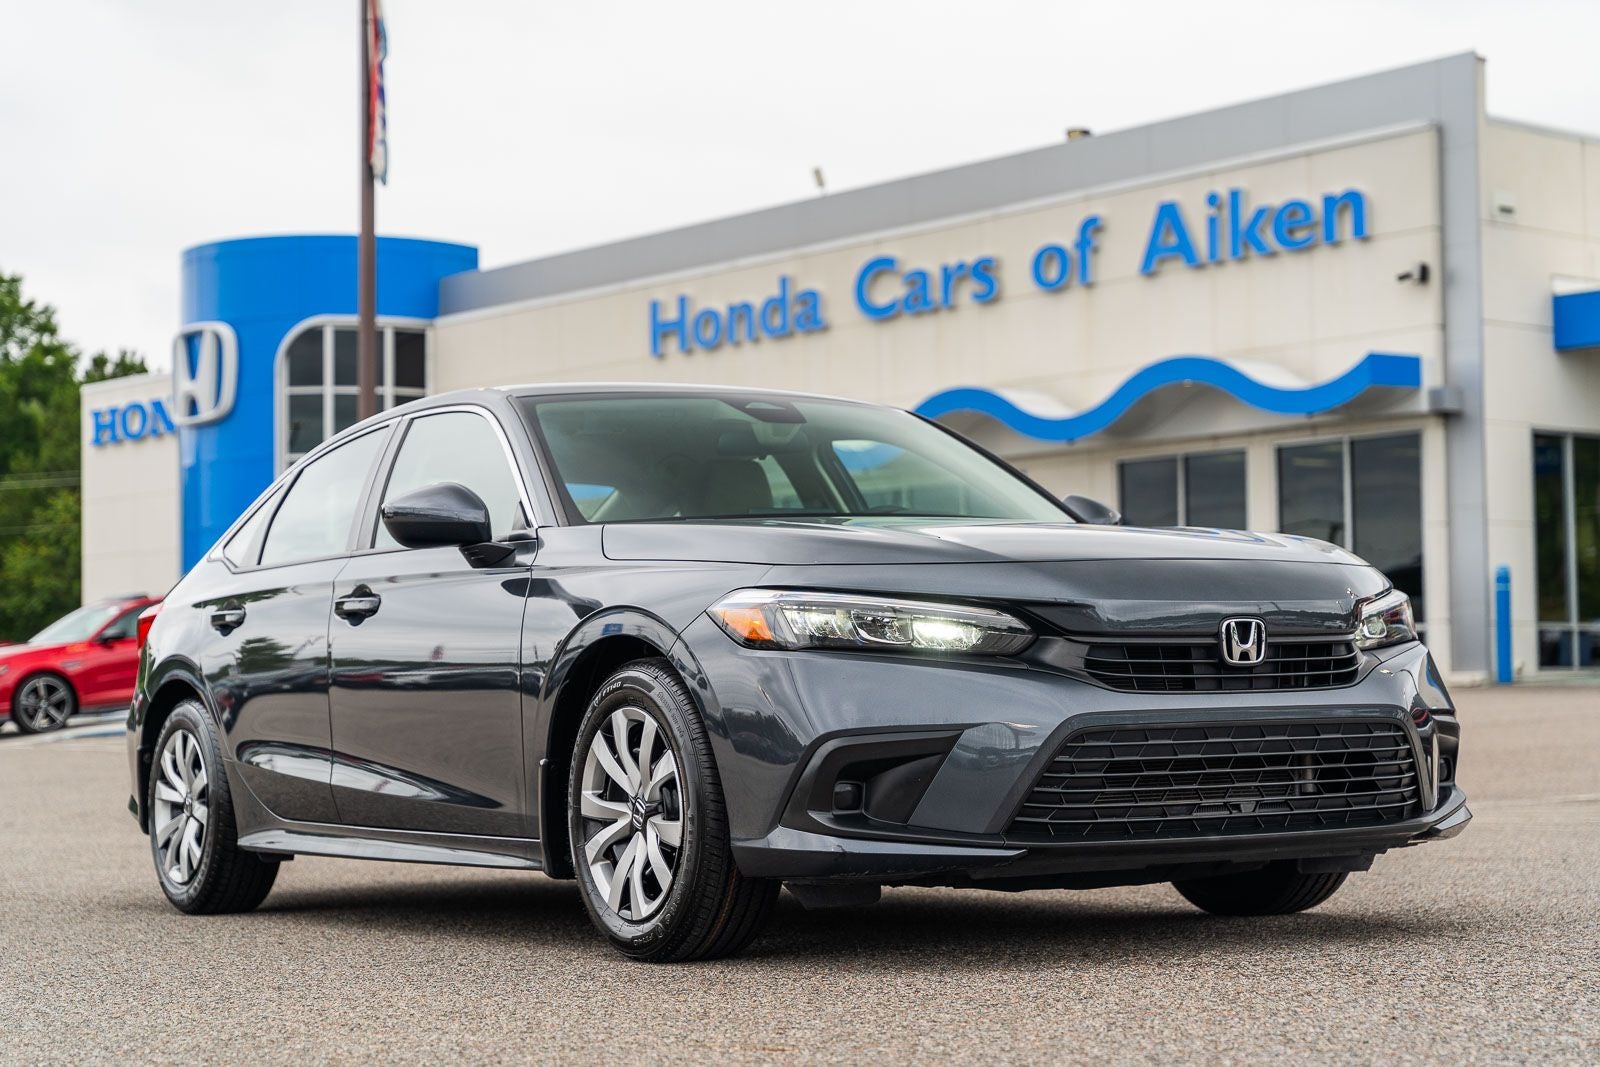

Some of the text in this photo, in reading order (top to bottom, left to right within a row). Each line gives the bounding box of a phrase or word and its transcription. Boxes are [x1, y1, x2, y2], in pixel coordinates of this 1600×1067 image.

[651, 188, 1367, 357] Honda Cars of Aiken
